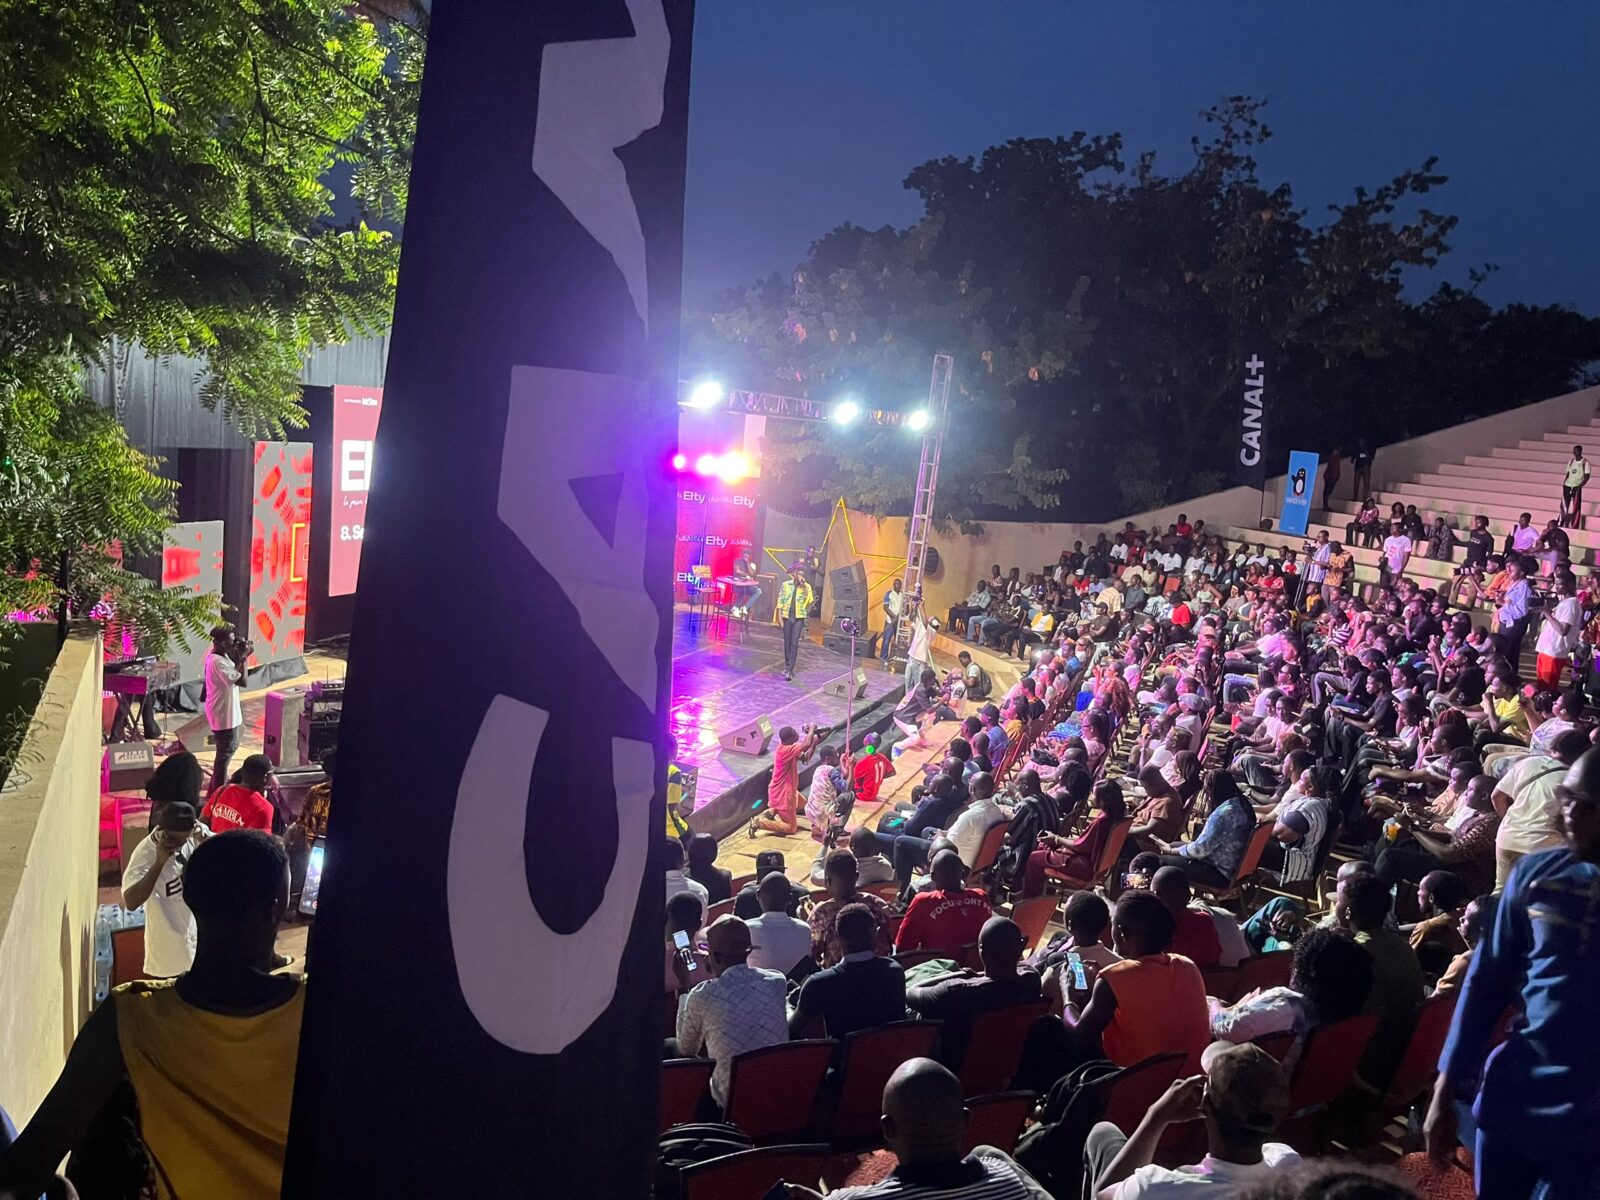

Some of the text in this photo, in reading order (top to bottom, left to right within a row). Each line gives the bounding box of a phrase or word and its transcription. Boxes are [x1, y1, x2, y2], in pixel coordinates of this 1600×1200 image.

[1240, 354, 1265, 467] CANAL+
[1285, 496, 1307, 506] wave
[874, 760, 884, 783] 11
